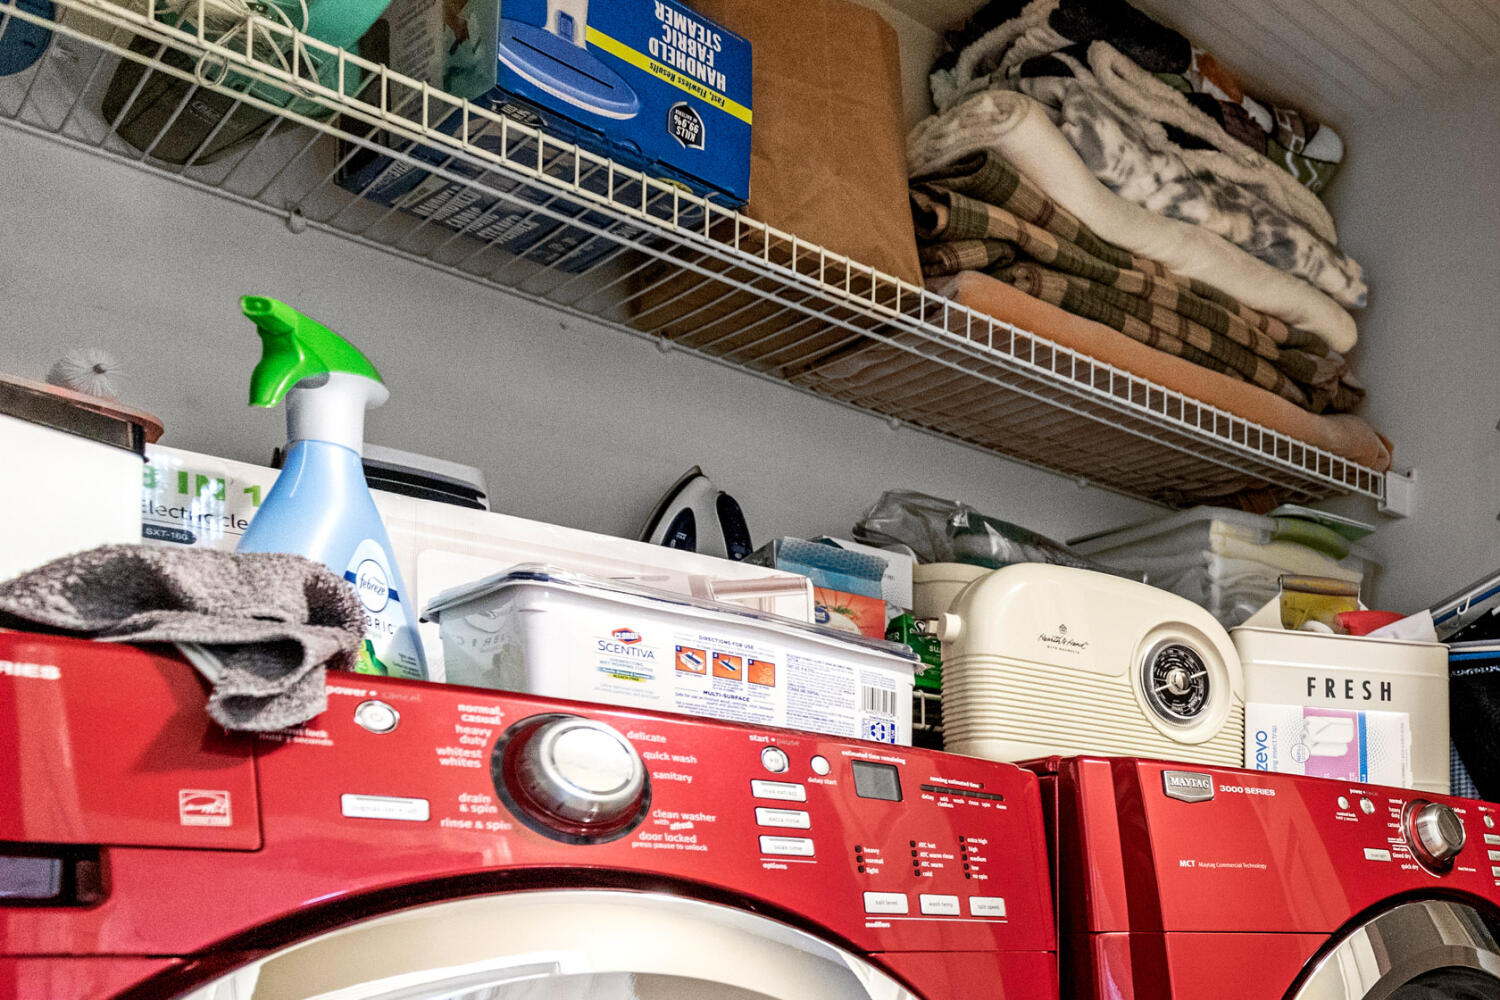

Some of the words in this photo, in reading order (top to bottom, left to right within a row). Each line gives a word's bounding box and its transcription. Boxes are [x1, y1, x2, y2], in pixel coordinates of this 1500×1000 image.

[654, 0, 722, 52] STEAMER
[662, 24, 714, 68] FABRIC
[648, 37, 726, 92] HANDHELD
[650, 61, 676, 81] Results
[678, 76, 708, 100] Flawless
[709, 91, 725, 107] Fast,
[674, 115, 699, 133] 99.9%
[676, 126, 696, 142] KILLS
[243, 485, 260, 508] 1
[366, 614, 394, 635] BRIC
[0, 660, 61, 680] RIES
[325, 685, 367, 698] power
[1307, 676, 1392, 702] FRESH
[461, 714, 502, 726] casual
[455, 724, 492, 739] heavy
[626, 730, 667, 744] delicate
[749, 734, 770, 743] start
[459, 735, 488, 748] duty
[436, 747, 483, 759] whitest
[643, 751, 670, 762] quick
[671, 753, 698, 764] wash
[1255, 730, 1269, 772] zevo
[438, 756, 482, 769] whites
[652, 771, 693, 785] sanitary
[1170, 776, 1209, 789] MAYTAG
[1219, 785, 1243, 793] 3000
[1245, 787, 1276, 796] SERIES
[458, 793, 492, 805] drain
[459, 803, 469, 814] &
[471, 804, 498, 815] spin
[652, 809, 680, 820] clean
[681, 811, 717, 823] washer
[440, 817, 474, 830] rinse
[474, 820, 484, 830] &
[485, 818, 512, 832] spin
[639, 831, 662, 842] door
[664, 832, 697, 844] locked
[632, 841, 652, 849] press
[654, 842, 675, 850] pause
[684, 843, 708, 852] unlock
[1179, 860, 1195, 868] MCT
